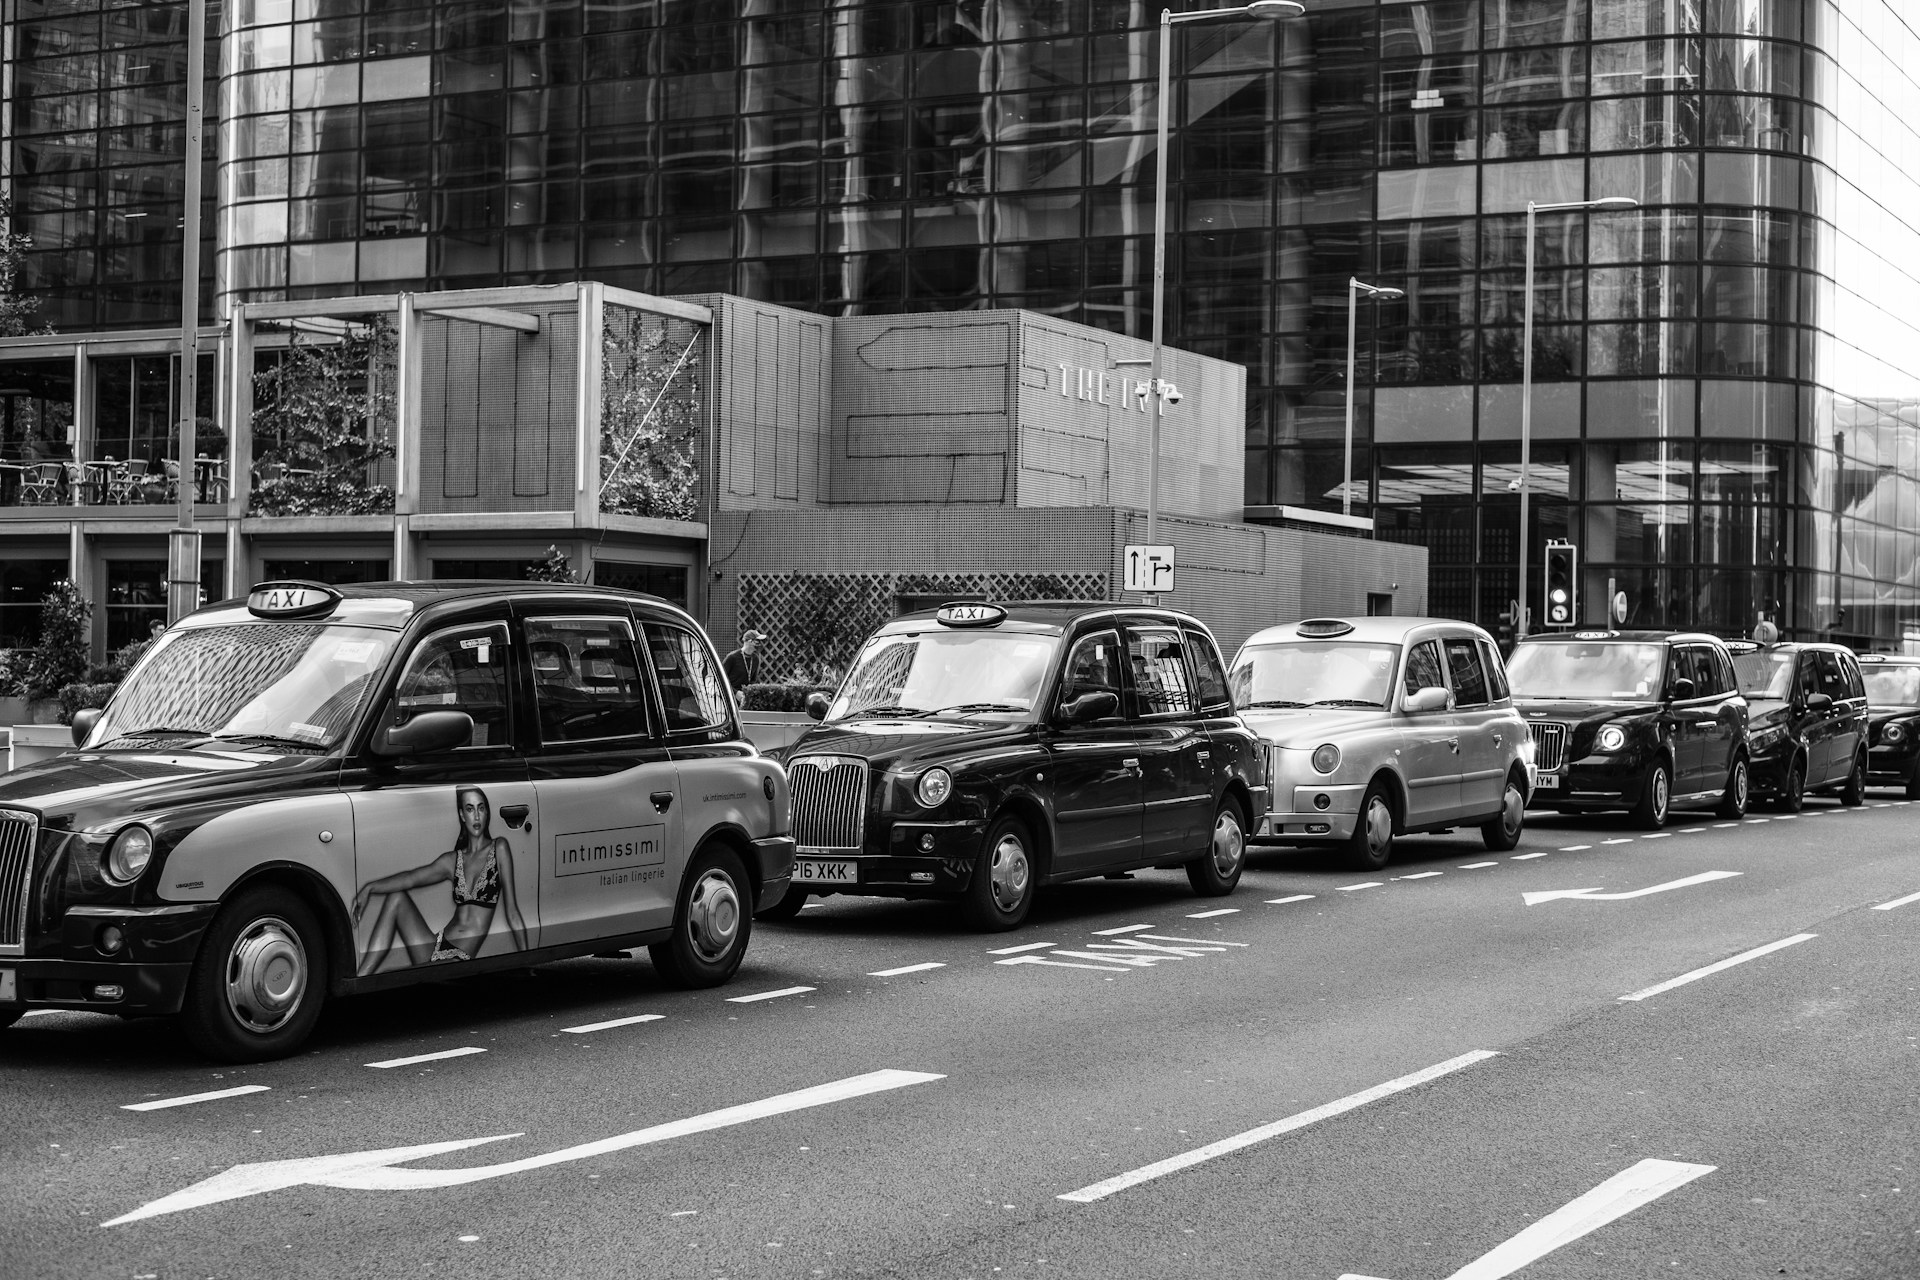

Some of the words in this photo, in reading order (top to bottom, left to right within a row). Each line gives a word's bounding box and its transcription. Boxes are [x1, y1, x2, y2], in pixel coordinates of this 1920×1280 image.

[1060, 364, 1109, 404] THE
[259, 591, 305, 608] TAXI
[947, 608, 984, 619] TAXI
[562, 839, 659, 864] intimissimi
[600, 873, 628, 886] Italian
[631, 867, 665, 883] lingerie
[817, 863, 847, 880] XKK
